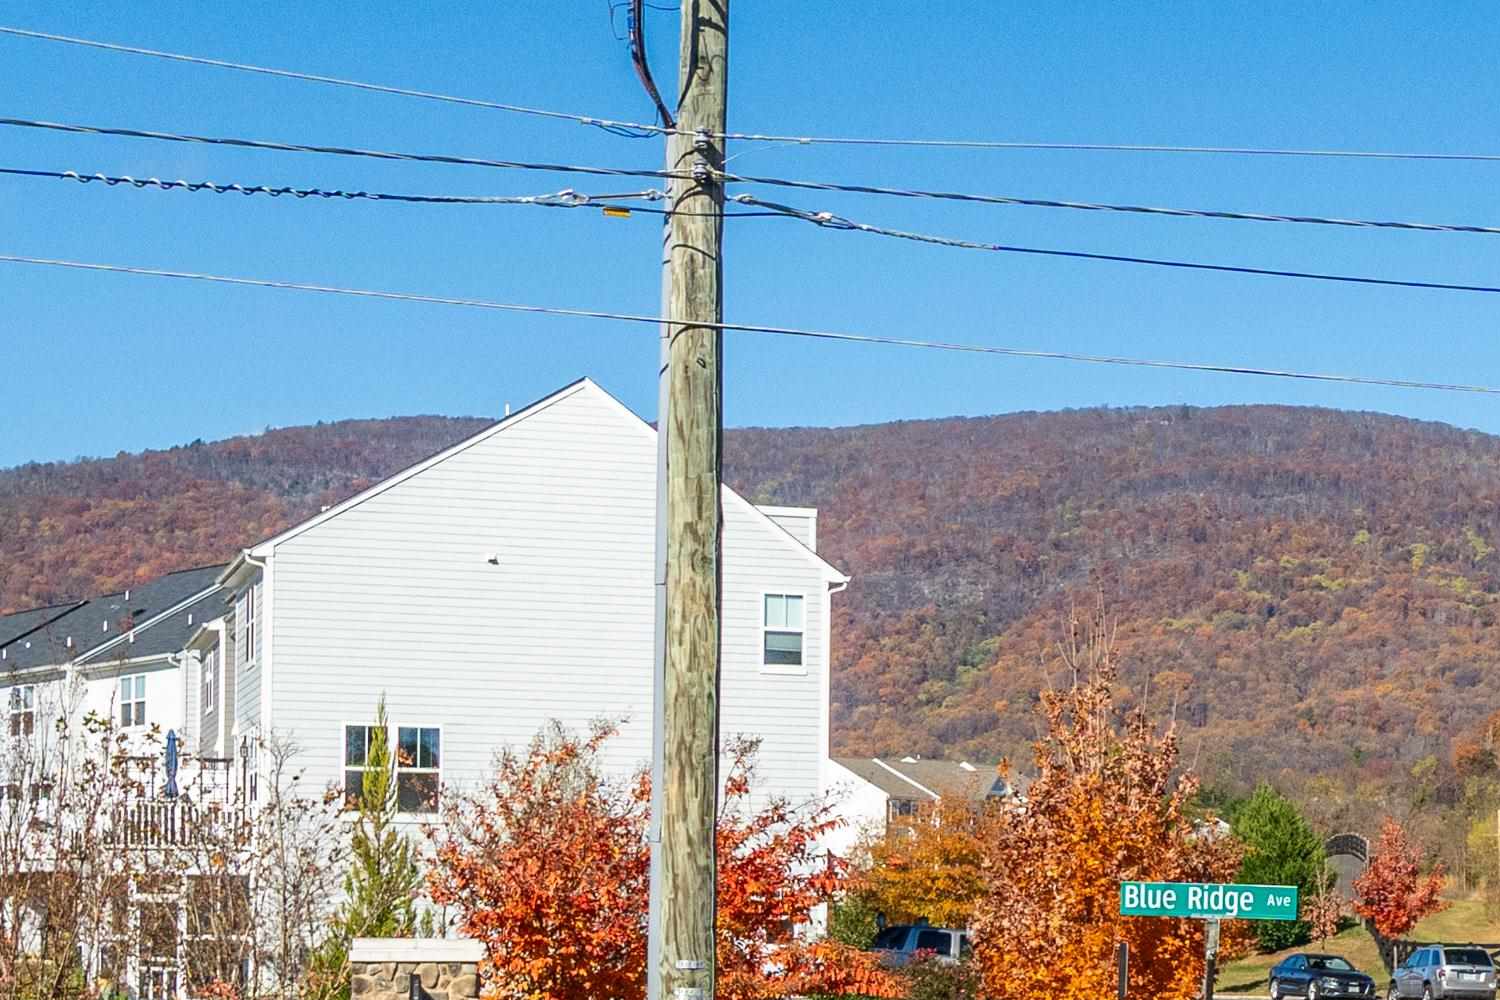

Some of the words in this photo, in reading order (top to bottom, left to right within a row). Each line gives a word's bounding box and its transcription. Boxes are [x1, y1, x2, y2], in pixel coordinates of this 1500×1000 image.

[1124, 884, 1177, 910] Blue
[1187, 885, 1254, 917] Ridge
[1266, 894, 1292, 908] Ave
